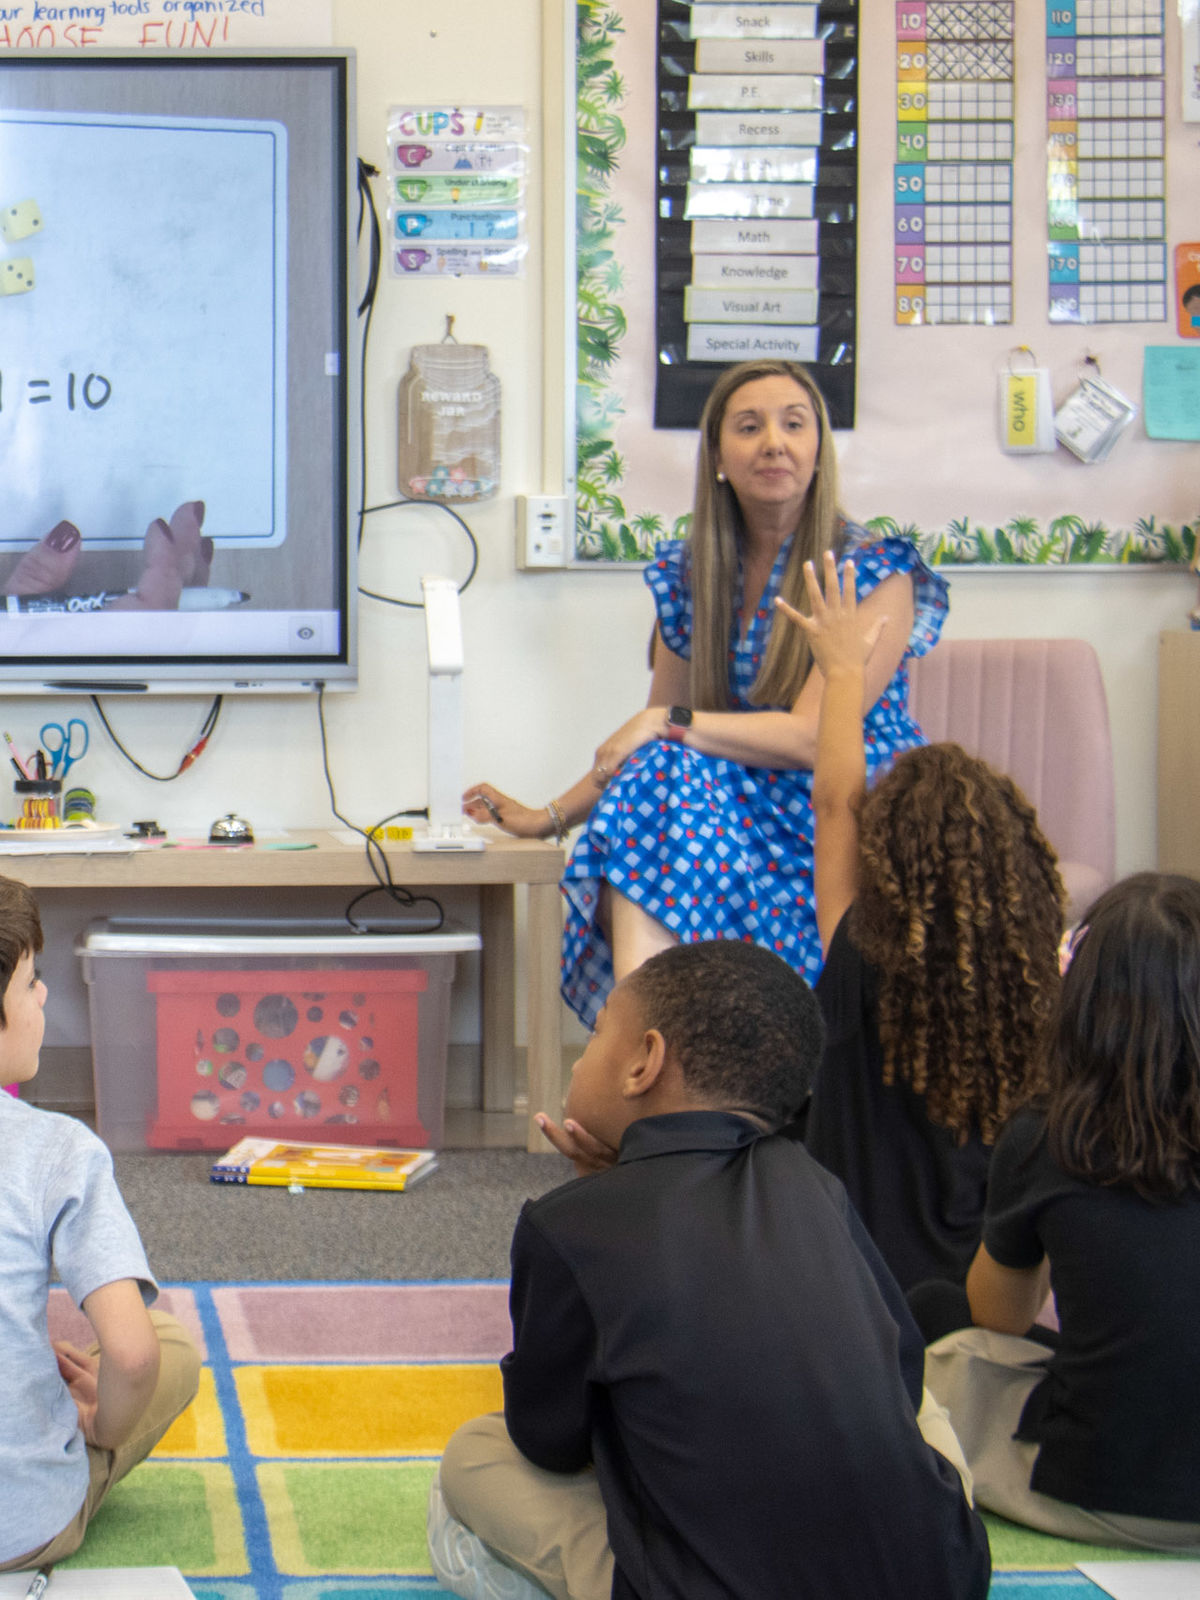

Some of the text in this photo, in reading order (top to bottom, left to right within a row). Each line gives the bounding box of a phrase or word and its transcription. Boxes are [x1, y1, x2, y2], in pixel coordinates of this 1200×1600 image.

[34, 1, 105, 26] learning
[110, 0, 150, 16] tools
[163, 0, 264, 22] organized
[1051, 11, 1072, 24] 110
[736, 16, 770, 27] Snack
[902, 14, 921, 28] 10
[744, 51, 774, 63] Skills
[900, 53, 925, 69] 20
[899, 94, 925, 110] 30
[400, 111, 465, 136] CUPS
[739, 124, 780, 135] Recess
[900, 134, 925, 150] 40
[897, 176, 922, 192] 50
[897, 217, 922, 232] 60
[738, 231, 770, 243] Math
[897, 256, 922, 272] 70
[721, 266, 788, 279] Knowledge
[722, 301, 781, 312] Visual Art
[898, 296, 923, 313] 80
[706, 337, 800, 352] Special Activity
[67, 373, 111, 411] 10
